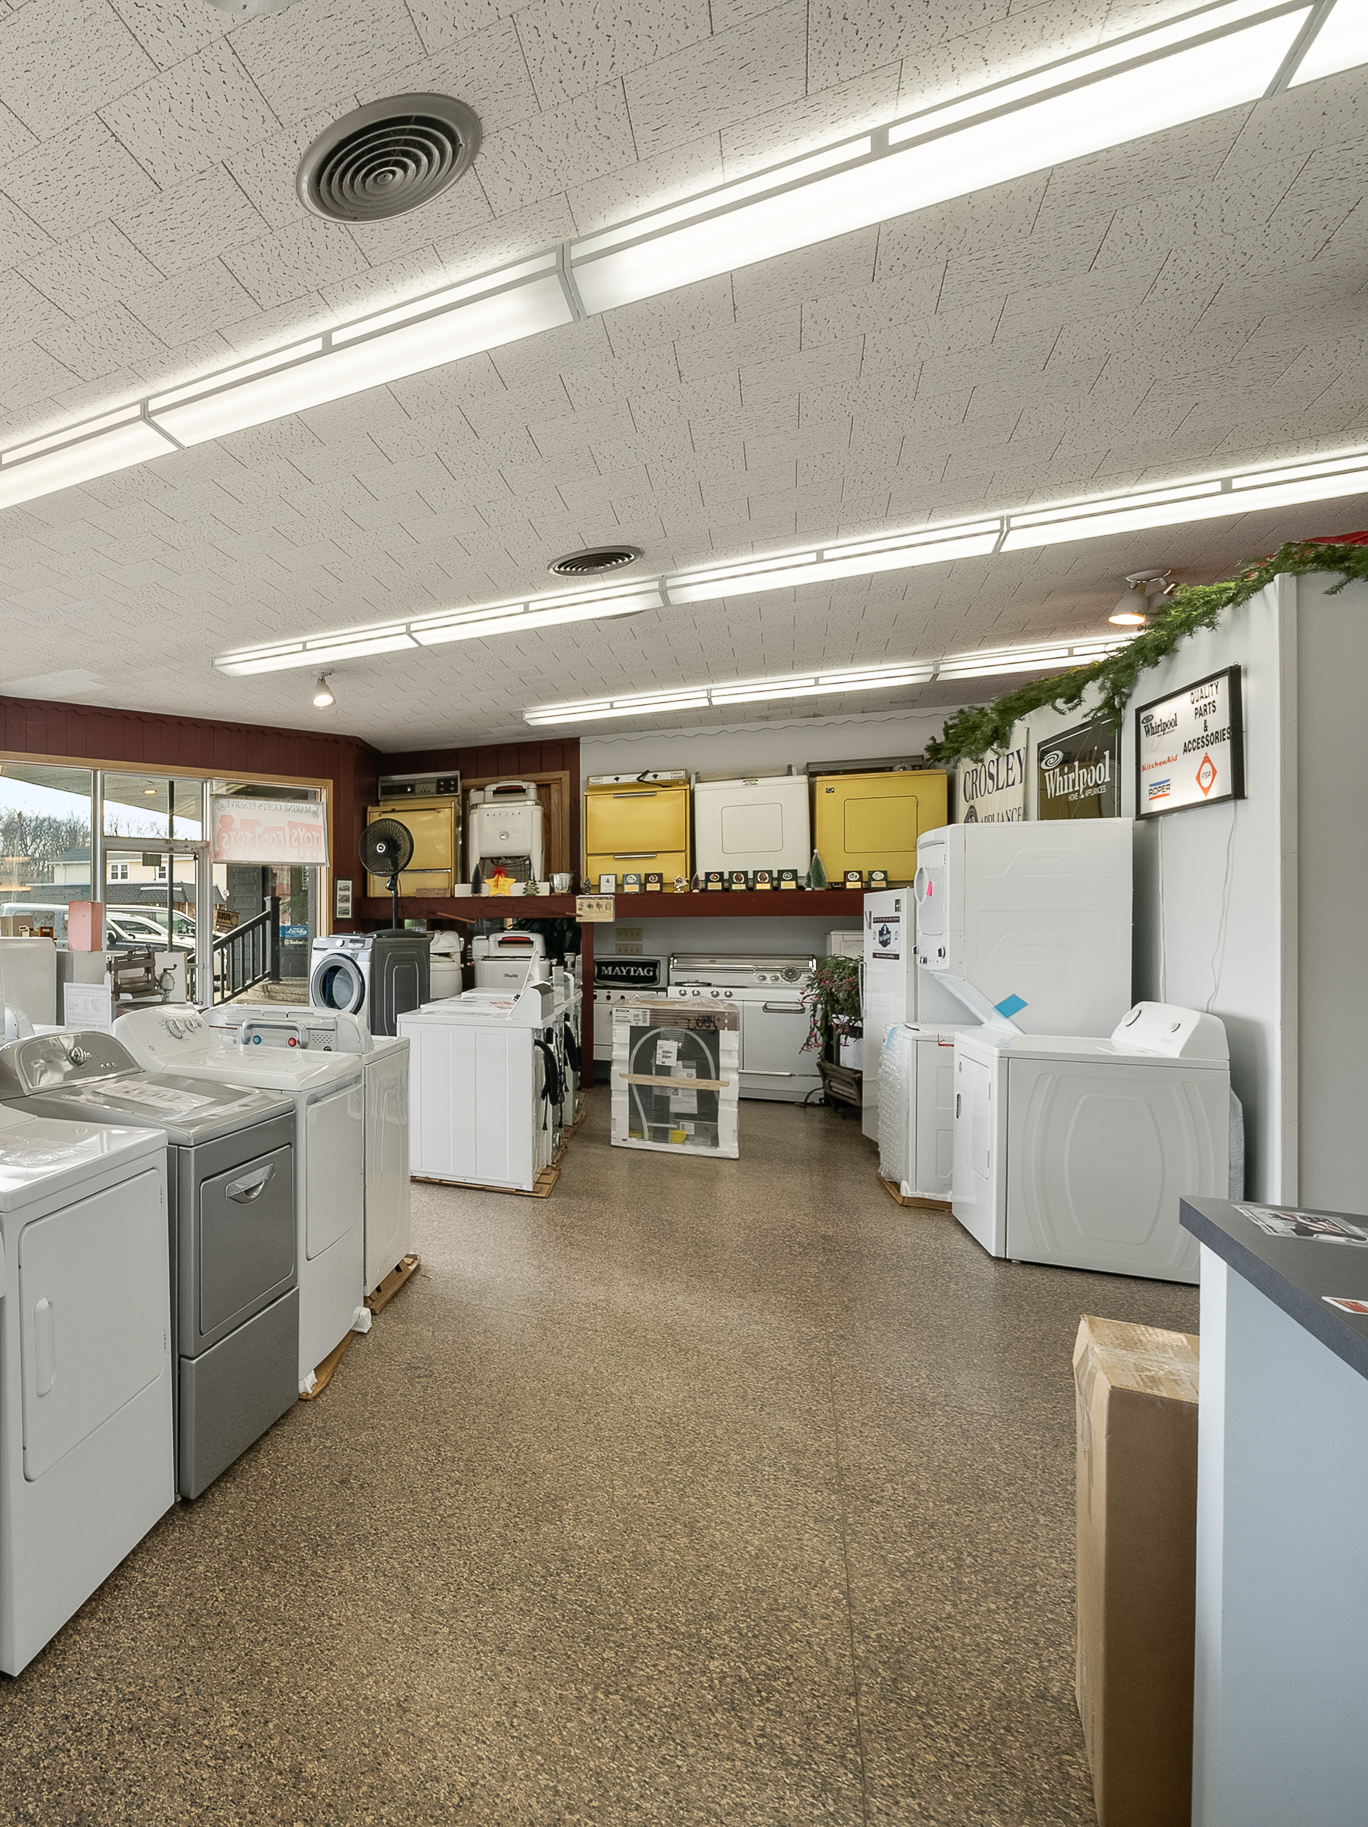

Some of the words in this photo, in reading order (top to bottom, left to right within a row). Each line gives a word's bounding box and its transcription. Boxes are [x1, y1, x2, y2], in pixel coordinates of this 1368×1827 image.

[1190, 681, 1219, 704] QUALITY
[1194, 700, 1217, 719] PARTS
[1144, 713, 1177, 738] Whirlpool
[1203, 719, 1208, 732] &
[1183, 727, 1231, 754] ACCESSORIES
[1142, 754, 1178, 772] KitchenAid
[963, 747, 1025, 803] CROSLEY
[1044, 750, 1111, 799] Whirlpool
[1201, 770, 1211, 779] FSP
[1148, 784, 1171, 796] ROPER
[981, 806, 1022, 823] IANCE
[601, 966, 654, 977] MAYTAG
